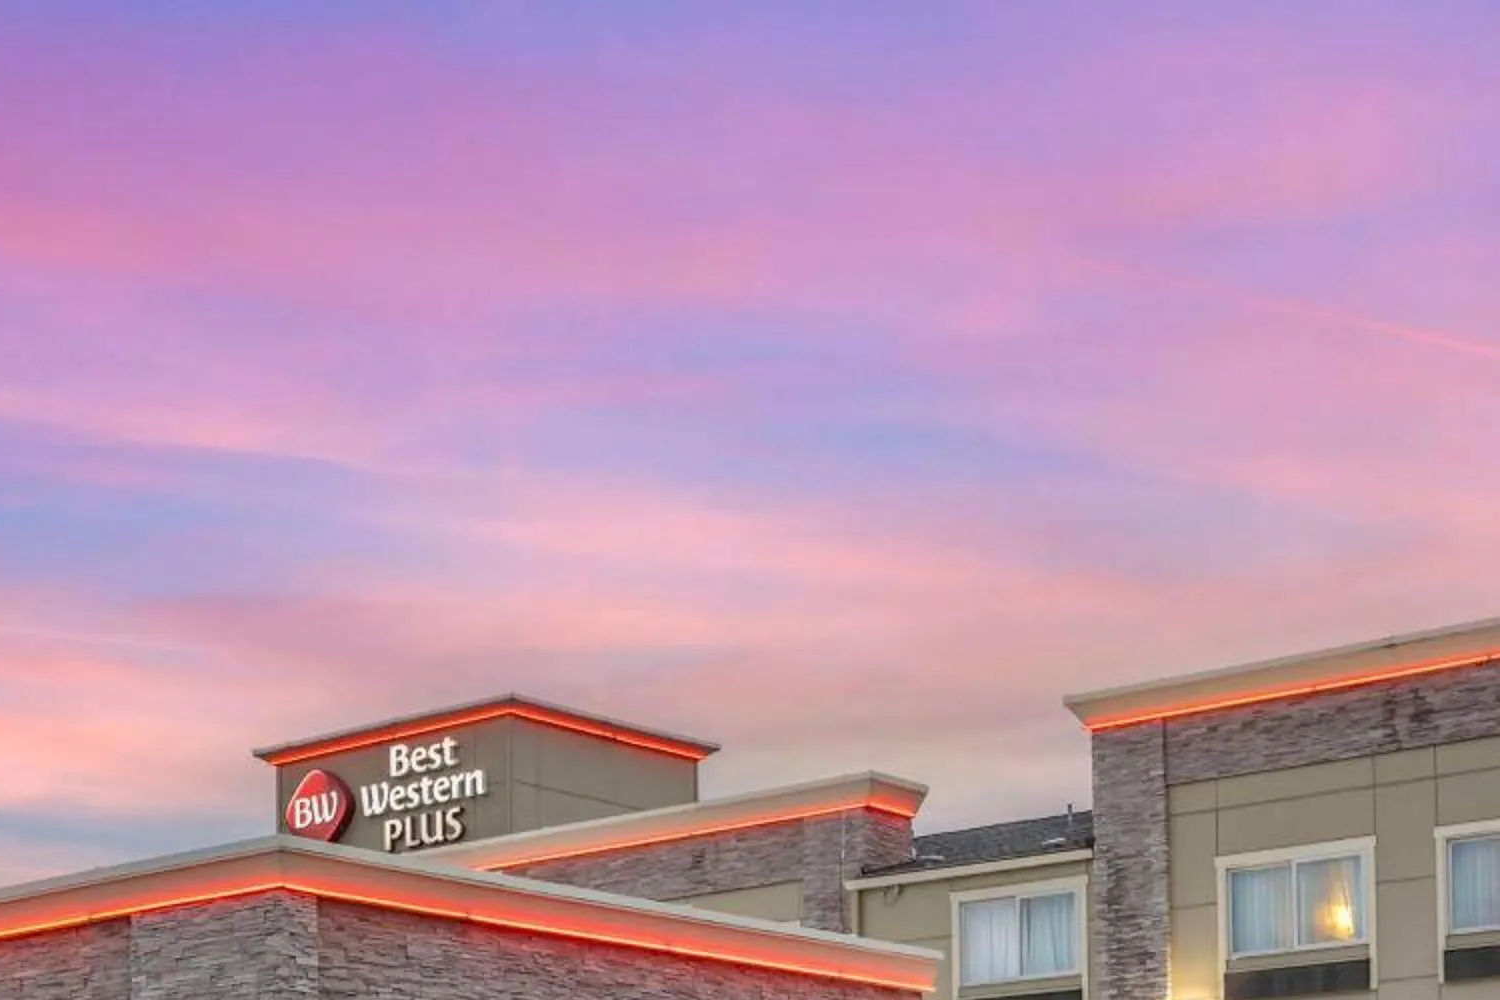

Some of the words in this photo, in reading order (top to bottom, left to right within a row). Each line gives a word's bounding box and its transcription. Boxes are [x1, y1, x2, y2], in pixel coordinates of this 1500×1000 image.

[389, 736, 459, 777] Best
[294, 791, 338, 829] BW
[360, 769, 486, 816] Western
[383, 806, 463, 851] PLUS
